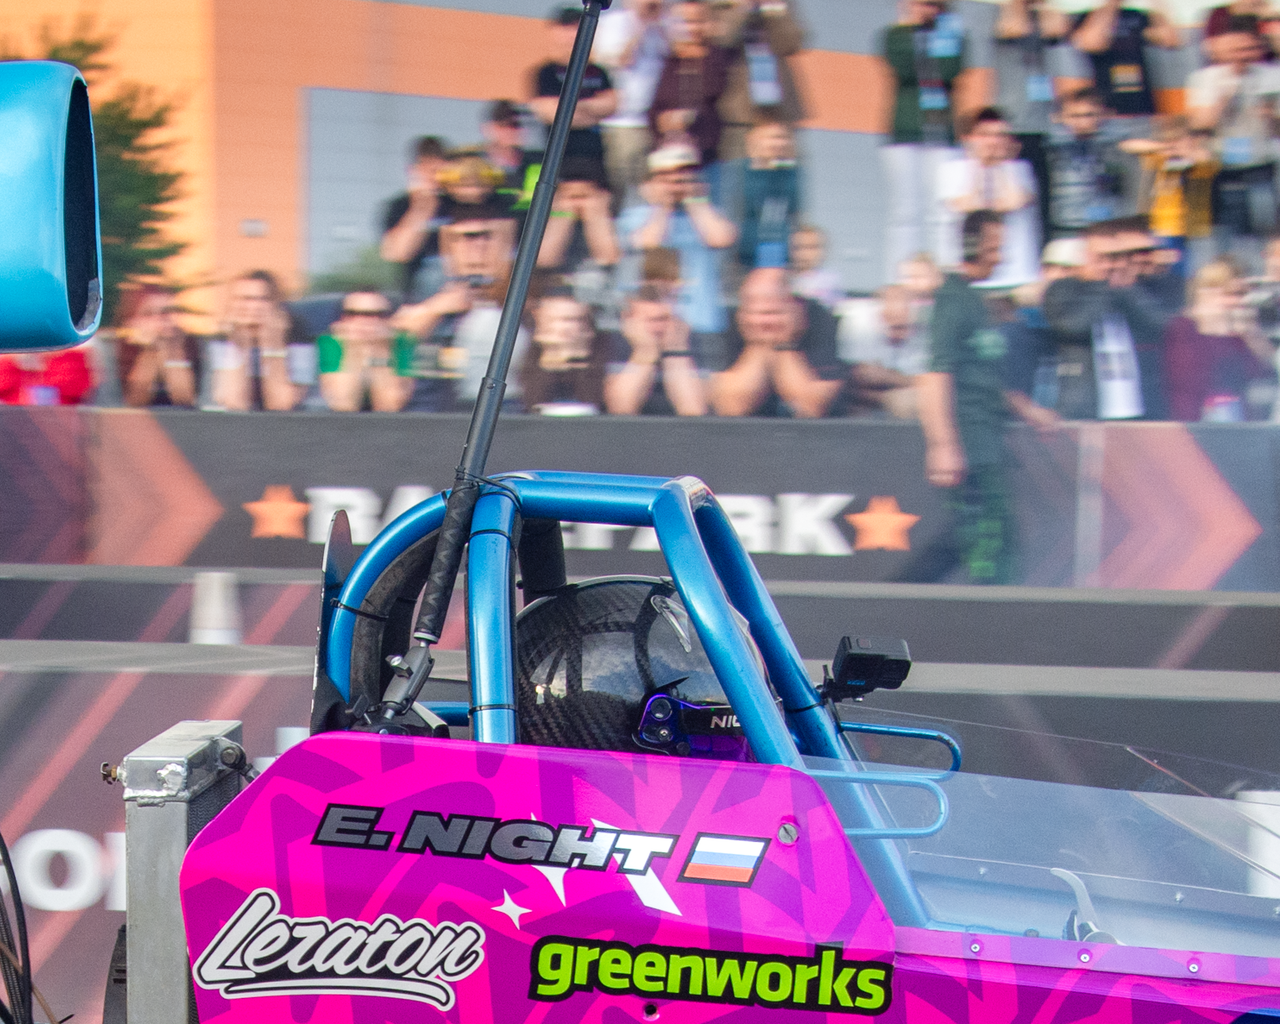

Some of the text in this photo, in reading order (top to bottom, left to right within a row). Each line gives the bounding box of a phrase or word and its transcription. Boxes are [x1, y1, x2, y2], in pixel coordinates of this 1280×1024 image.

[317, 806, 676, 873] E. NIGHT
[537, 940, 886, 1010] greenworks
